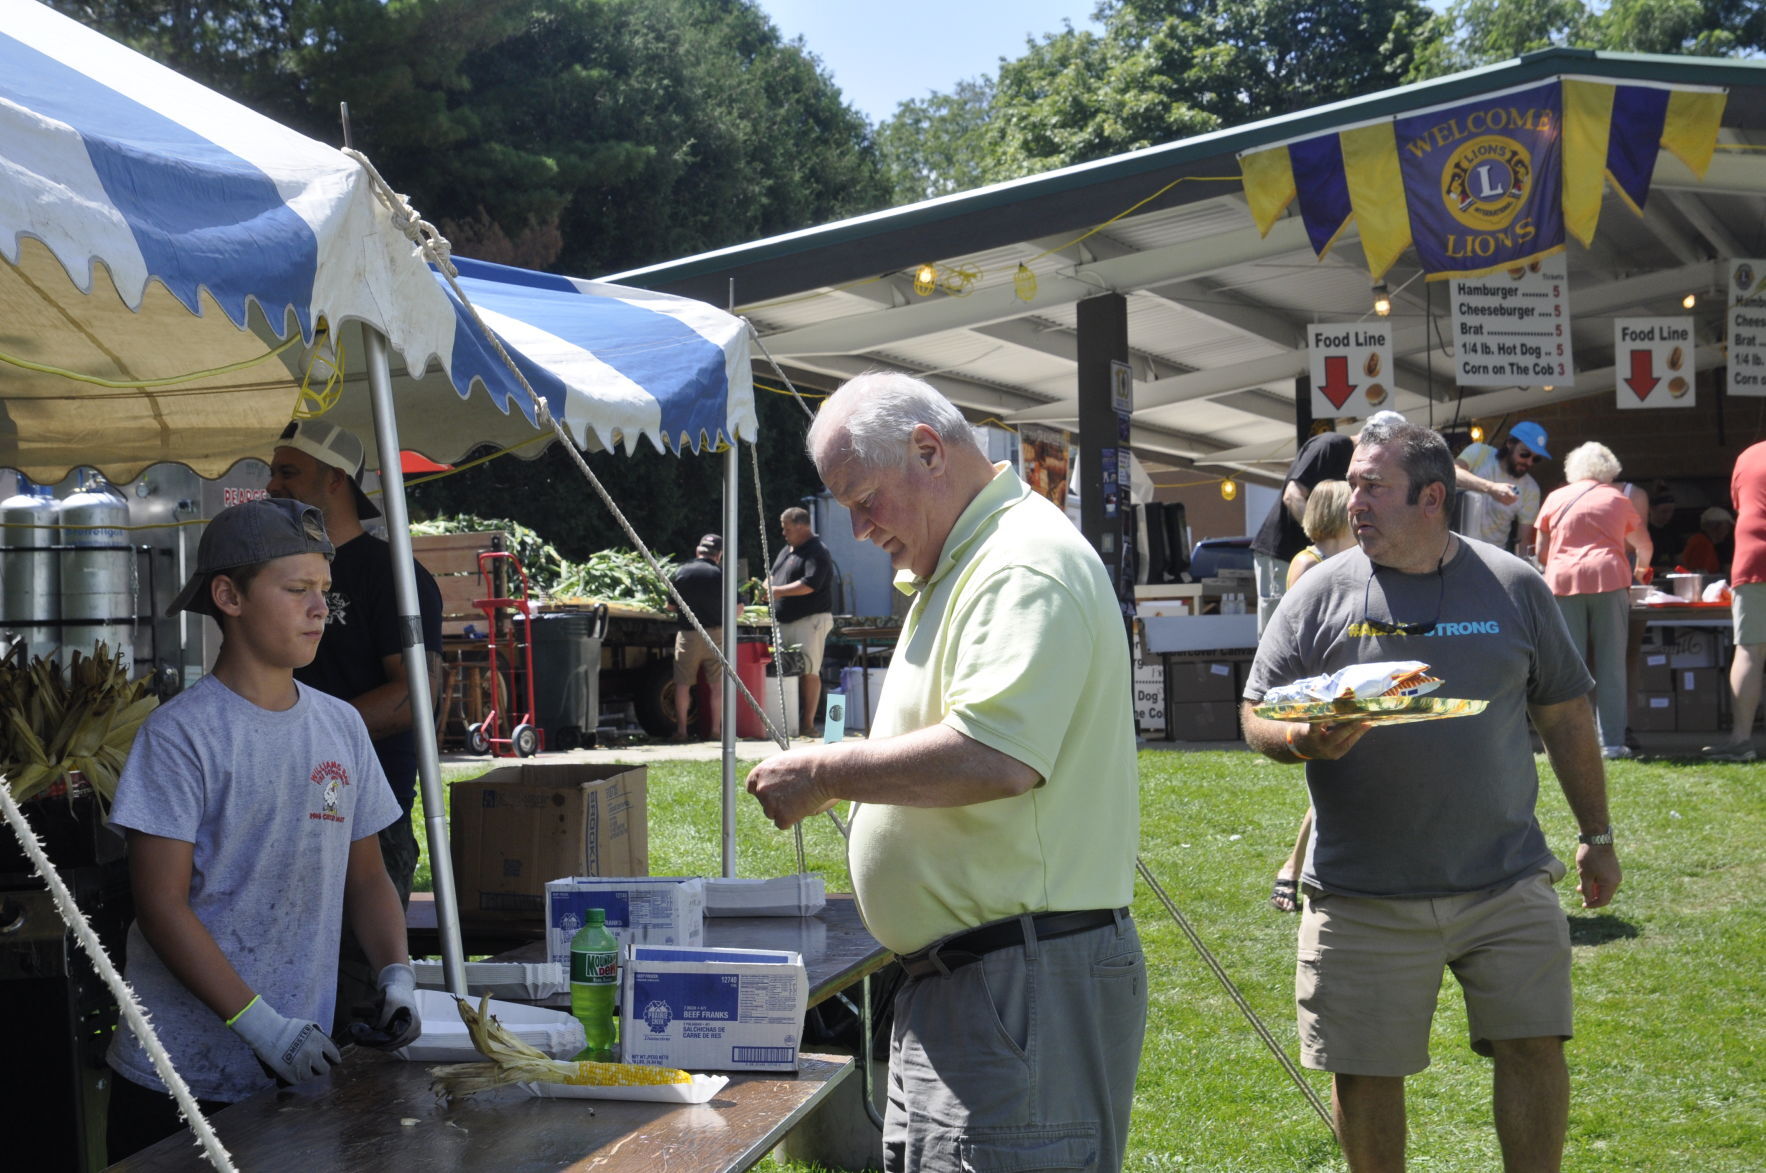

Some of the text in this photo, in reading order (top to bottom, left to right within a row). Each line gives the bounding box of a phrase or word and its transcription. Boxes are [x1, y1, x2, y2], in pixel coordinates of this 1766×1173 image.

[1406, 107, 1553, 158] WELCOME
[1464, 144, 1508, 164] LIONS
[1477, 165, 1504, 198] L
[1445, 217, 1536, 258] LIONS
[1457, 283, 1560, 300] Hamburger 5
[1459, 302, 1562, 320] Cheeseburger 5
[1460, 322, 1562, 337] Brat 5
[1621, 326, 1689, 342] Food Line
[1314, 331, 1386, 348] Food Line
[1734, 333, 1756, 346] Brat
[1462, 342, 1564, 359] 1/4 lb. Hot Dog 5
[1735, 353, 1765, 367] 1/4 lb.
[1463, 361, 1565, 376] Corn on The Cob 3
[1734, 372, 1759, 385] Corn
[1138, 690, 1158, 704] Dog
[1148, 707, 1164, 719] Co
[701, 1011, 729, 1019] FRANKS
